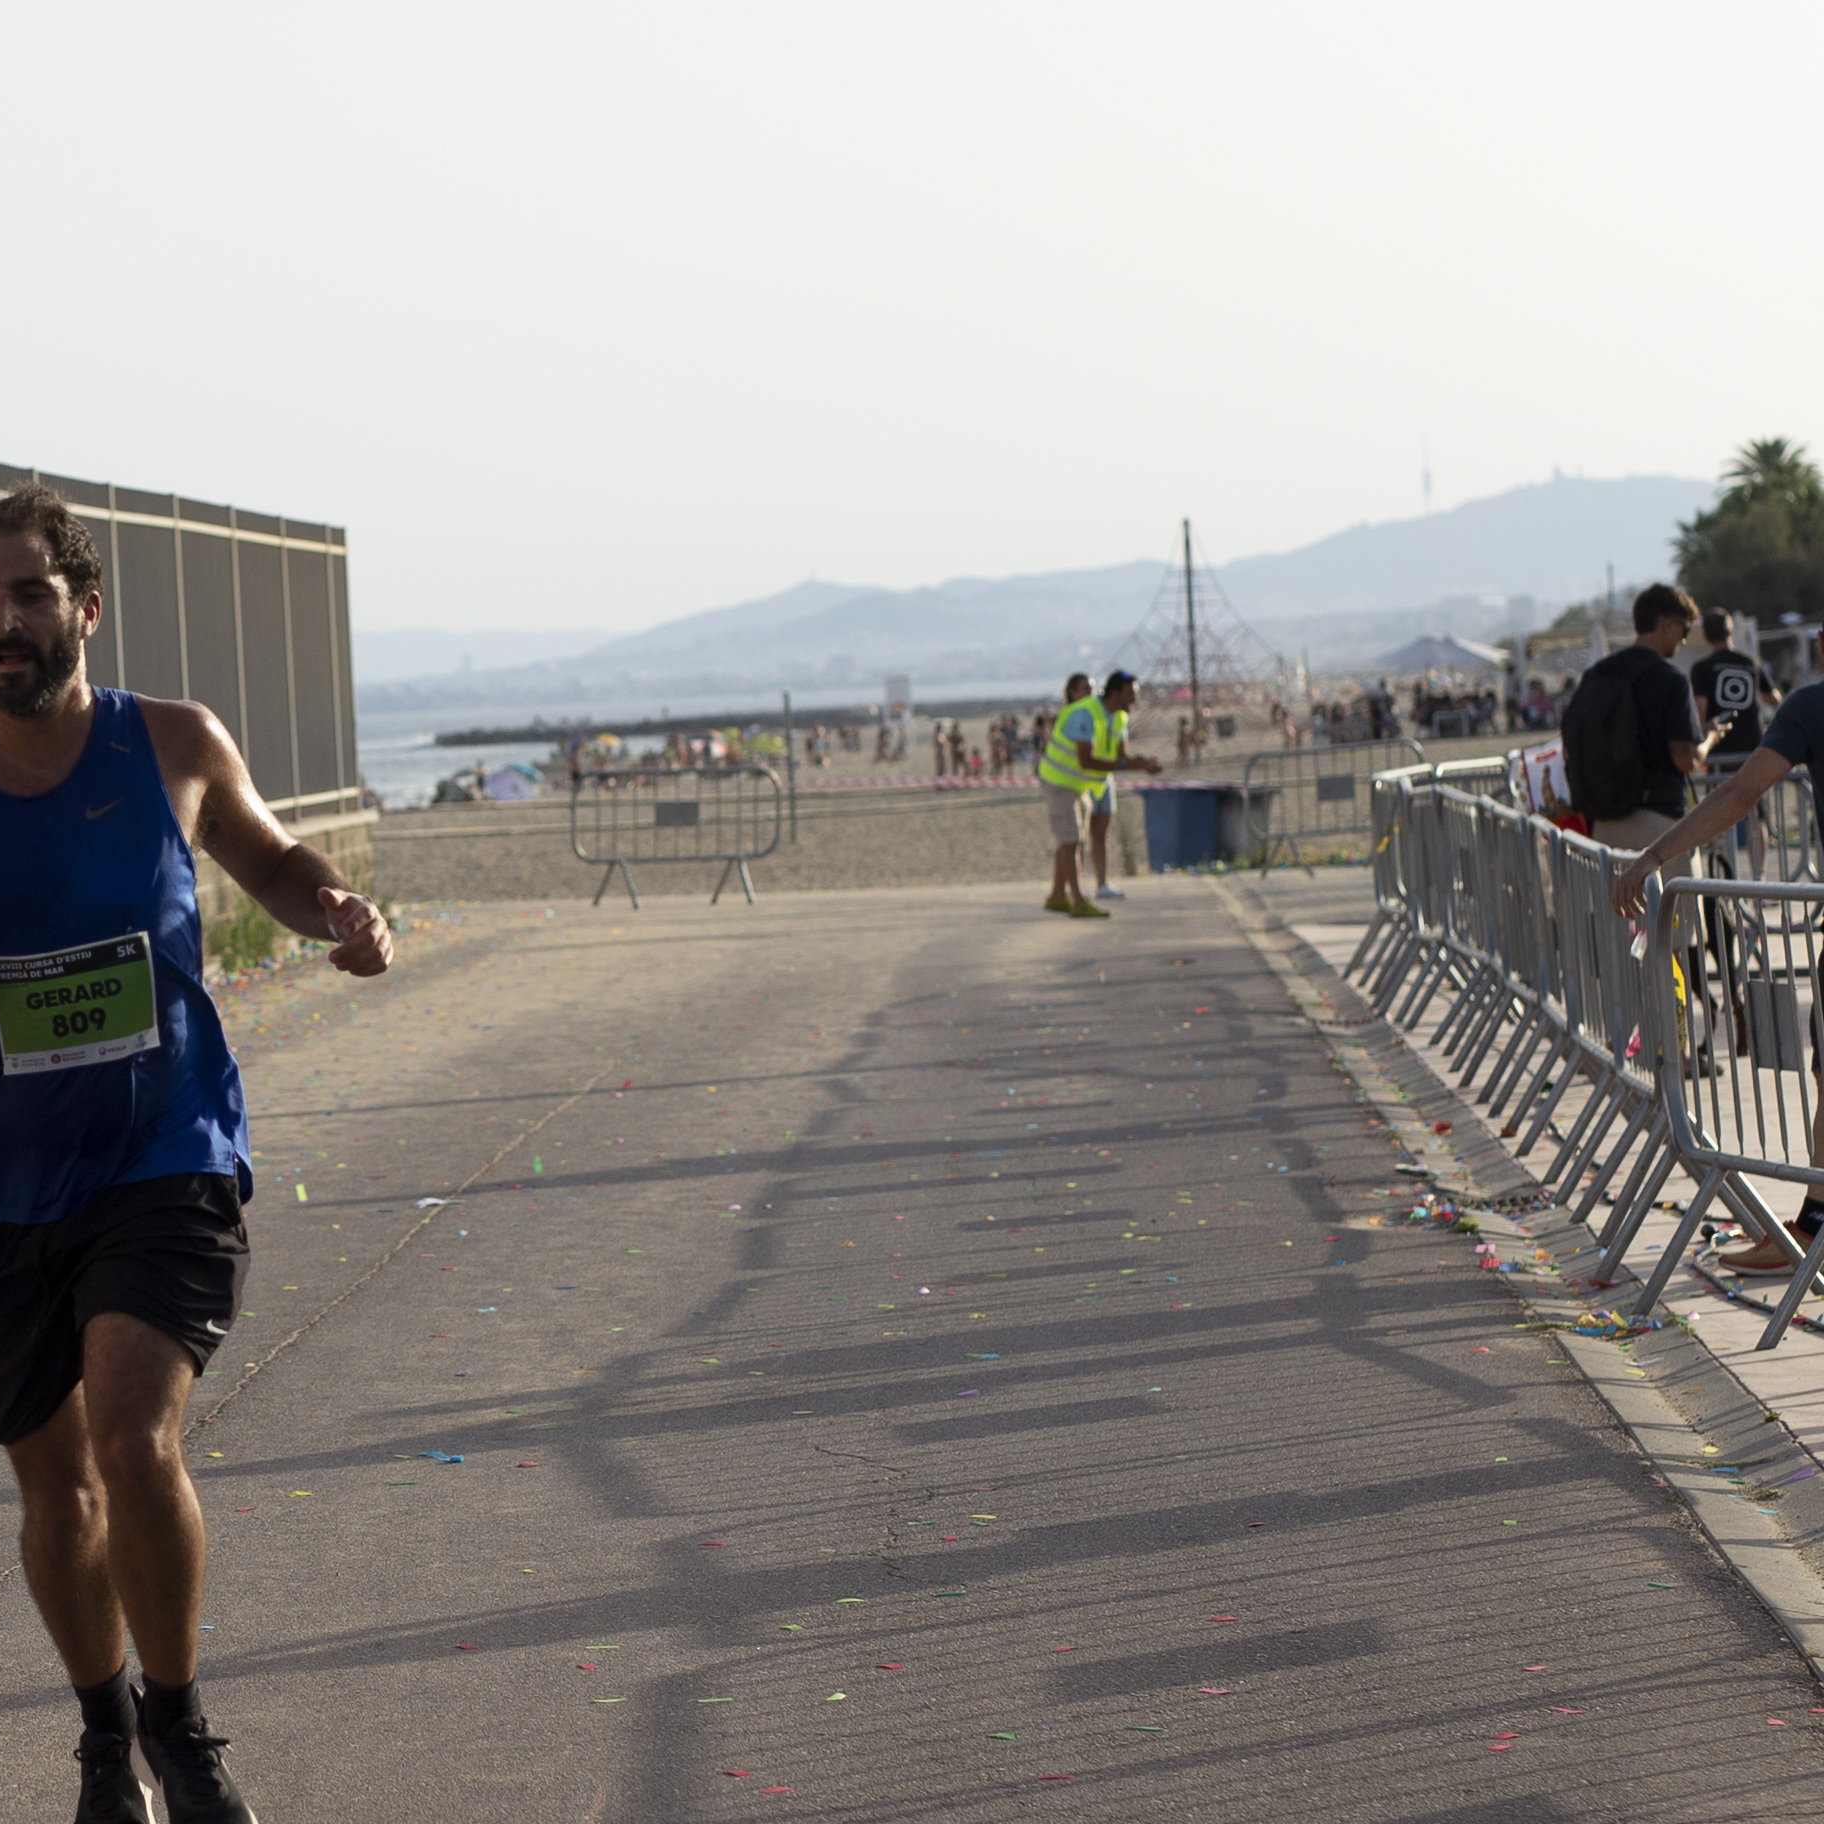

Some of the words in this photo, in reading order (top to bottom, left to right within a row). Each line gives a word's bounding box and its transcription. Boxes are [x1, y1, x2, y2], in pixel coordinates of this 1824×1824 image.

[24, 959, 55, 970] CURSA
[56, 951, 92, 964] D'ESTIU
[117, 943, 137, 958] 5K
[29, 970, 43, 978] DE
[44, 966, 65, 976] MAR
[25, 978, 123, 1010] GERARD
[52, 1007, 107, 1037] 809
